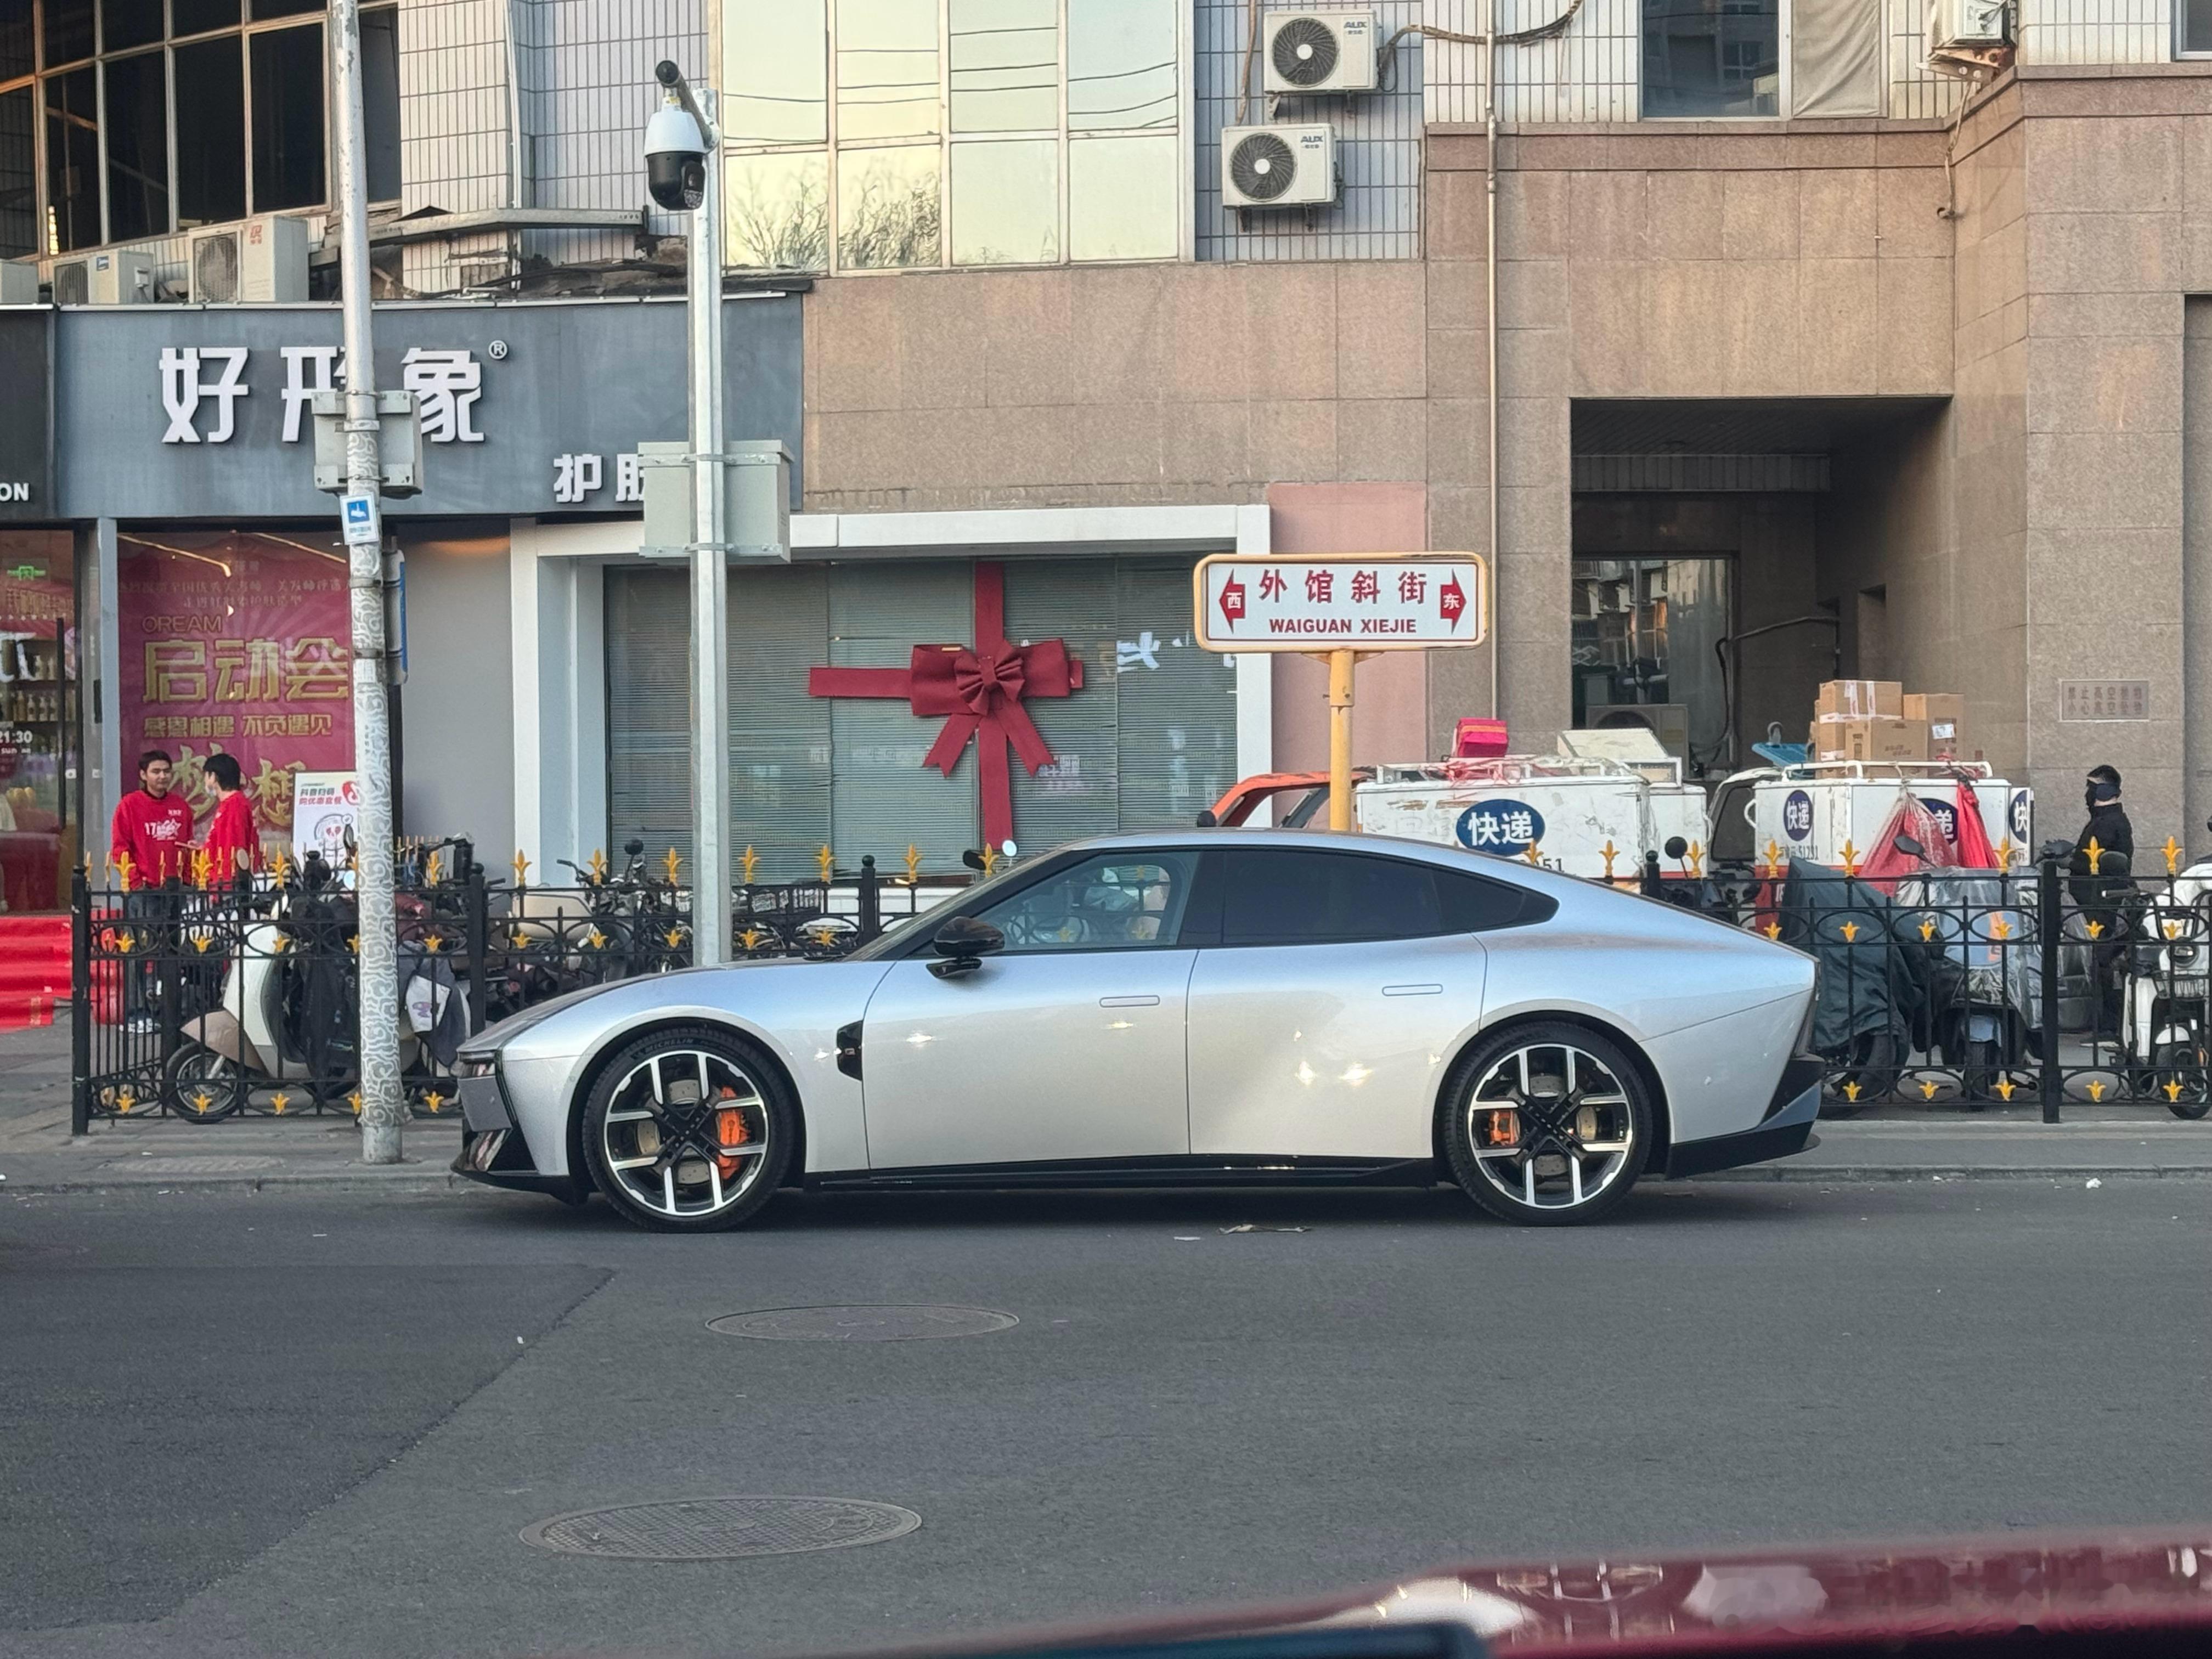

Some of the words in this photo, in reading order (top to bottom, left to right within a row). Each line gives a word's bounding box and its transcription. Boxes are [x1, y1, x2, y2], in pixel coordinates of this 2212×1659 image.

[1226, 591, 1243, 609] 西
[1259, 568, 1427, 604] 外馆斜街
[1442, 592, 1460, 610] 东
[1269, 618, 1352, 633] WAIGUAN
[1360, 619, 1417, 633] XIEJIE
[142, 637, 349, 703] 启动会
[144, 714, 235, 738] 感恩相遇
[242, 714, 332, 737] 不负遇见
[1467, 811, 1534, 847] 快递
[1786, 800, 1810, 831] 快递
